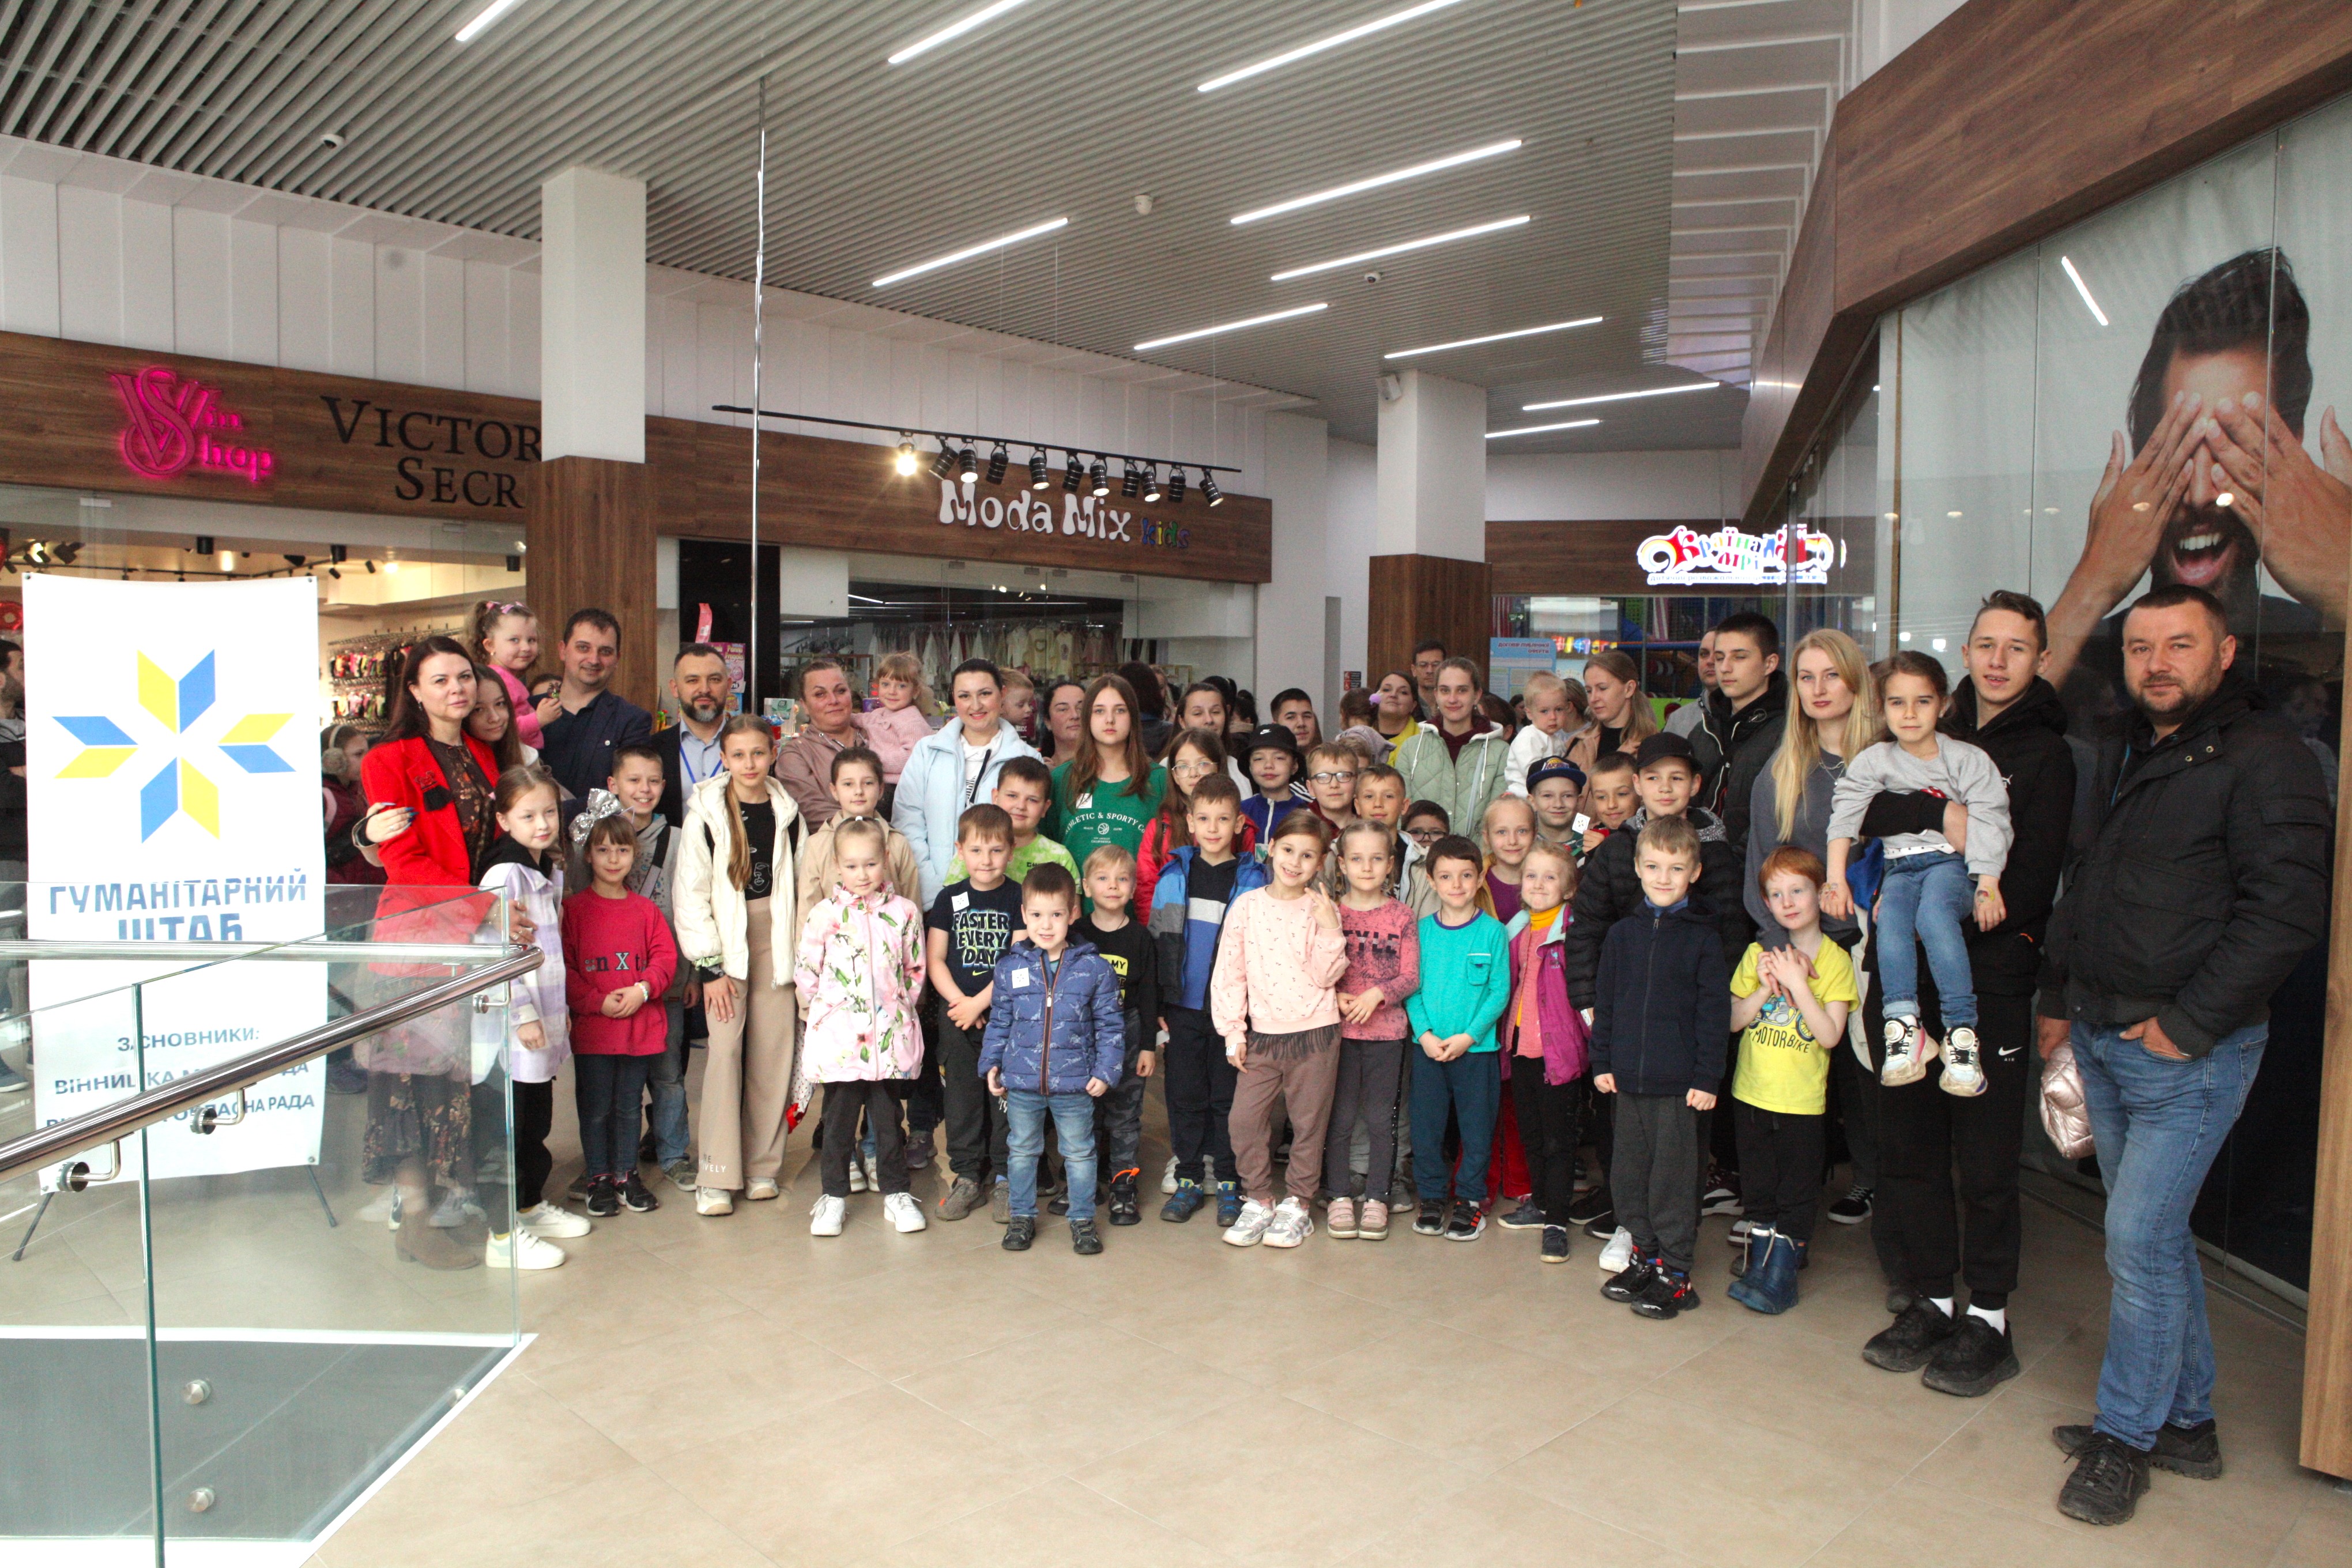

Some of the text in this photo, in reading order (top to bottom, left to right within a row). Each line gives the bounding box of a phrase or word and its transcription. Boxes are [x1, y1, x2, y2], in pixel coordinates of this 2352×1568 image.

[939, 479, 1191, 549] Moda Mix kids
[1106, 812, 1139, 826] SPORTY
[50, 868, 307, 915] ГУМАНІТАРНИЙ
[952, 911, 1010, 930] FASTER
[957, 929, 1008, 949] EVERY
[963, 947, 996, 967] DAY
[1752, 1026, 1811, 1053] MOTORBIKE
[268, 1094, 315, 1111] РАДА
